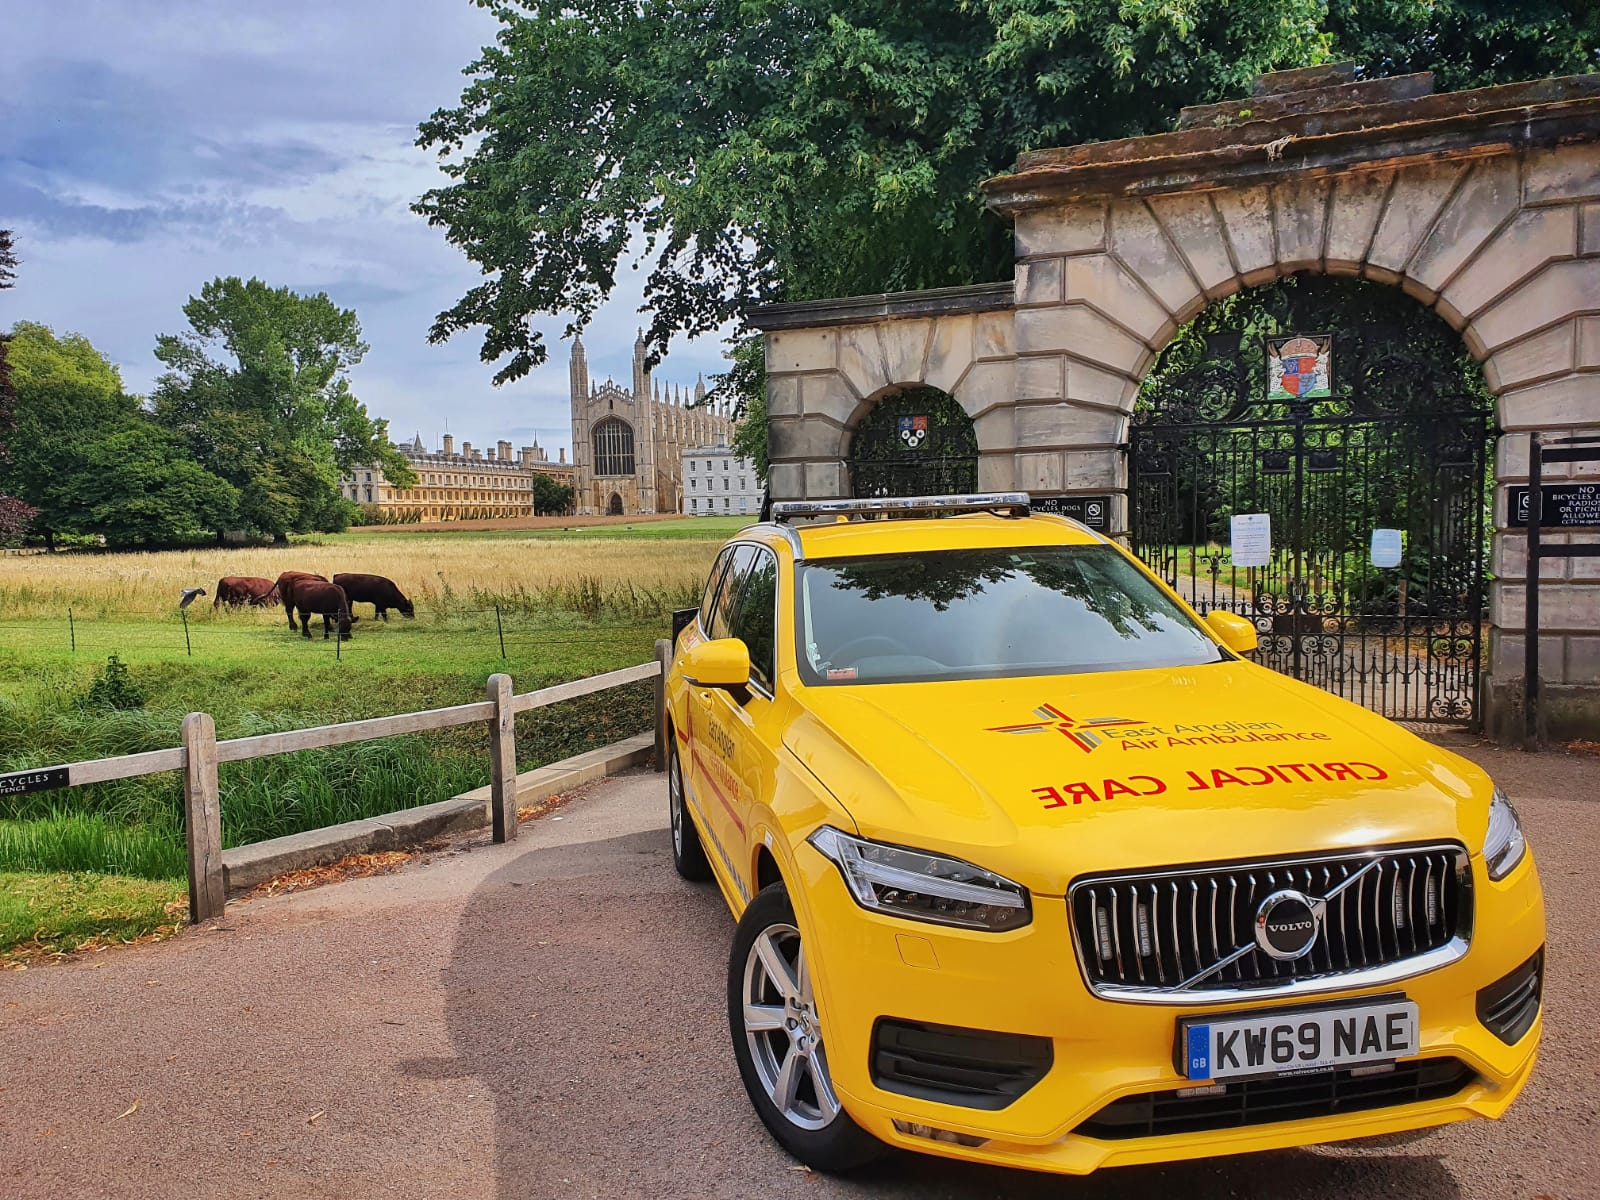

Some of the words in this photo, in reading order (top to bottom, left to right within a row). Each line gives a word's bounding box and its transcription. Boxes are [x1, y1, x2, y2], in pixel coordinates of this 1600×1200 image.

[1579, 486, 1595, 494] NO
[1100, 725, 1168, 739] East
[1174, 720, 1284, 734] Anglian
[1121, 739, 1159, 751] Air
[1167, 728, 1333, 748] Ambulance
[1268, 921, 1312, 932] VOLVO
[1192, 1057, 1207, 1069] GB
[1216, 1022, 1321, 1070] KW69
[1333, 1011, 1409, 1057] NAE
